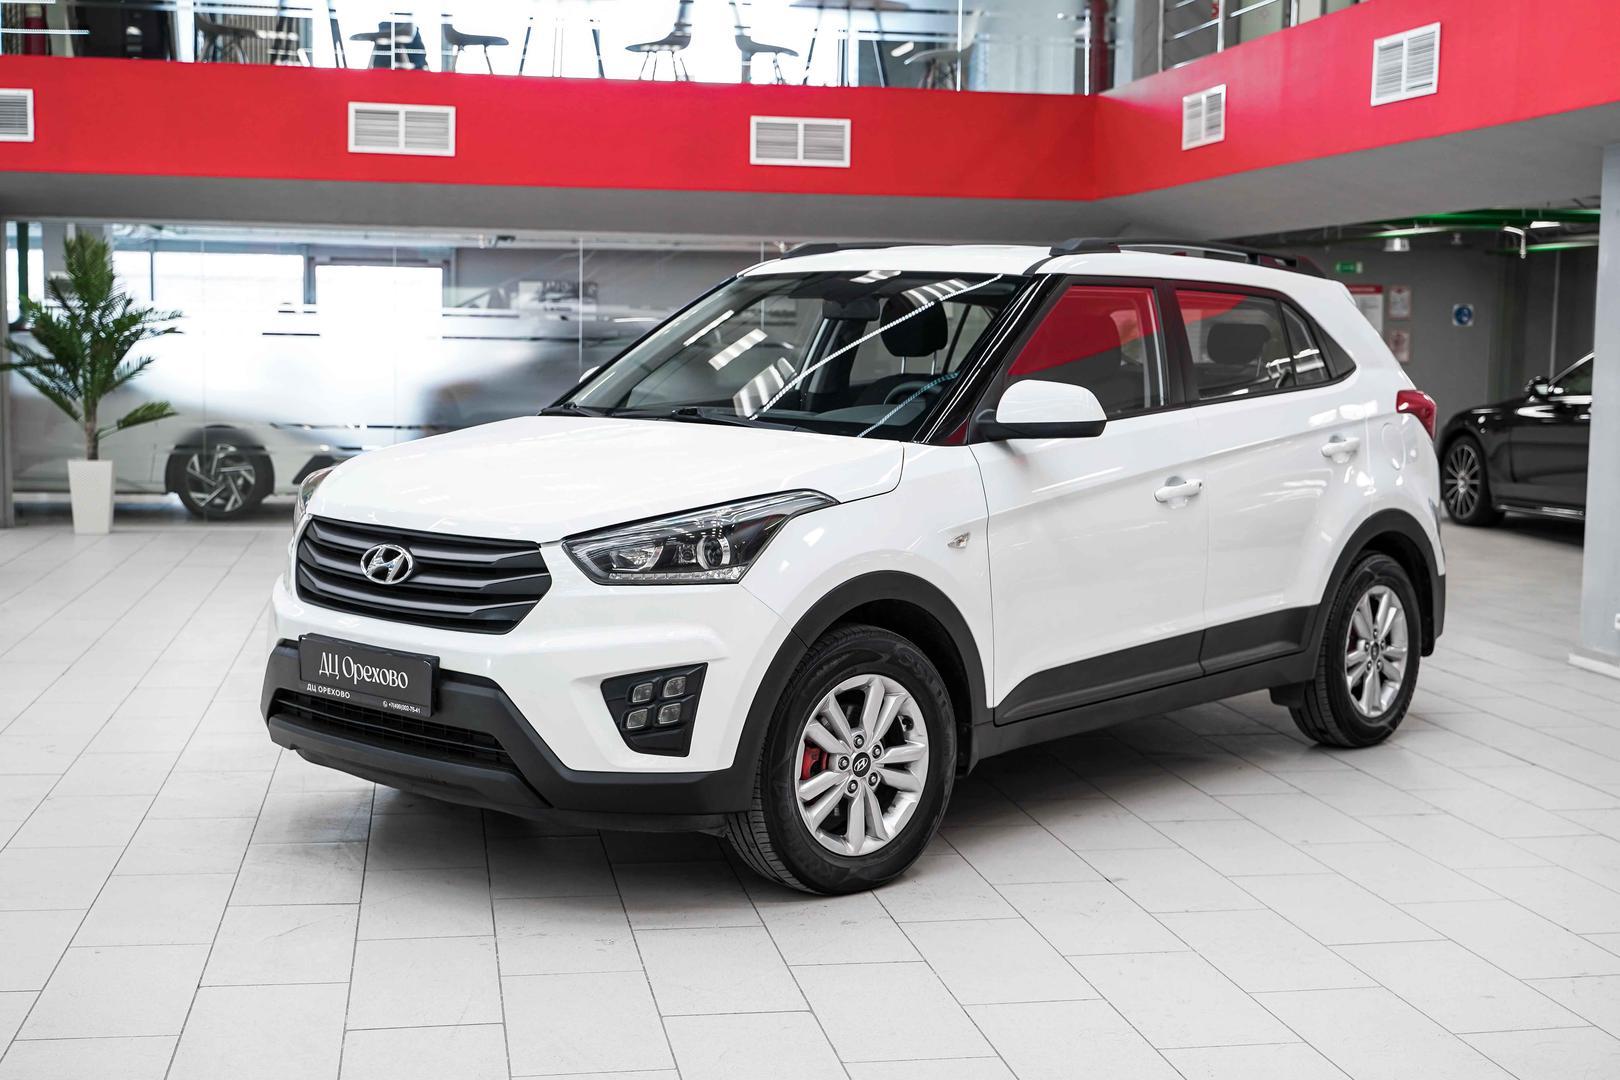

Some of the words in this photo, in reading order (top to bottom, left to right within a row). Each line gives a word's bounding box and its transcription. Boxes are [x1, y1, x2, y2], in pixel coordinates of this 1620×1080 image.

[319, 652, 339, 680] ДЦ
[342, 656, 408, 689] Орехово
[306, 684, 317, 693] ДЦ
[318, 686, 350, 699] ОРЕХОВО
